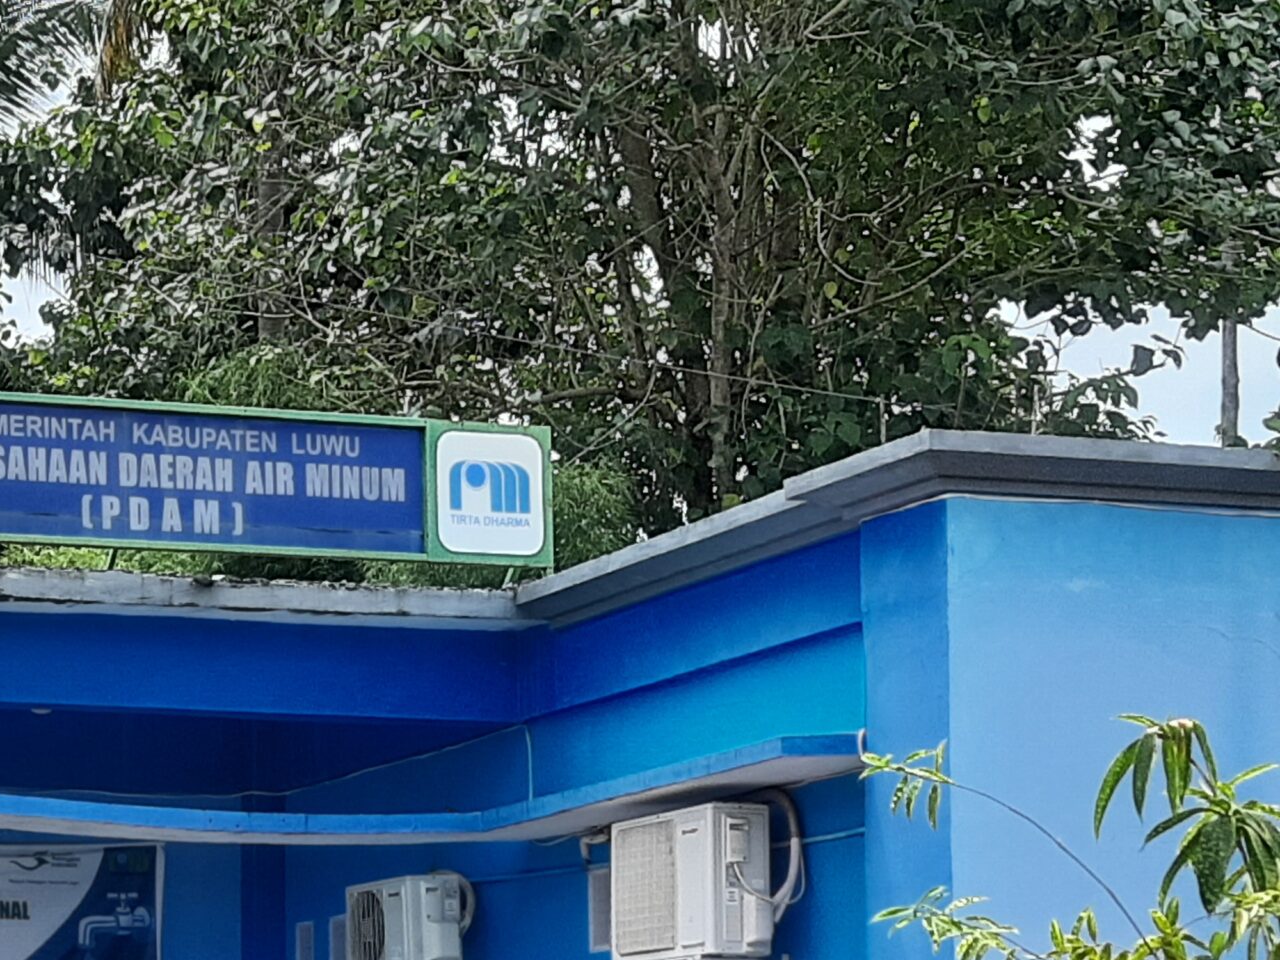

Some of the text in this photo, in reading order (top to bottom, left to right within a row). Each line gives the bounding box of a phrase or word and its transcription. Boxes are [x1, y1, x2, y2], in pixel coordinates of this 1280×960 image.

[132, 422, 277, 453] KABUPATEN
[292, 434, 360, 458] LUWU
[118, 452, 233, 493] DAERAH
[245, 460, 295, 496] AIR
[306, 464, 405, 502] MINUM
[451, 514, 530, 528] TIRTA DHARMA
